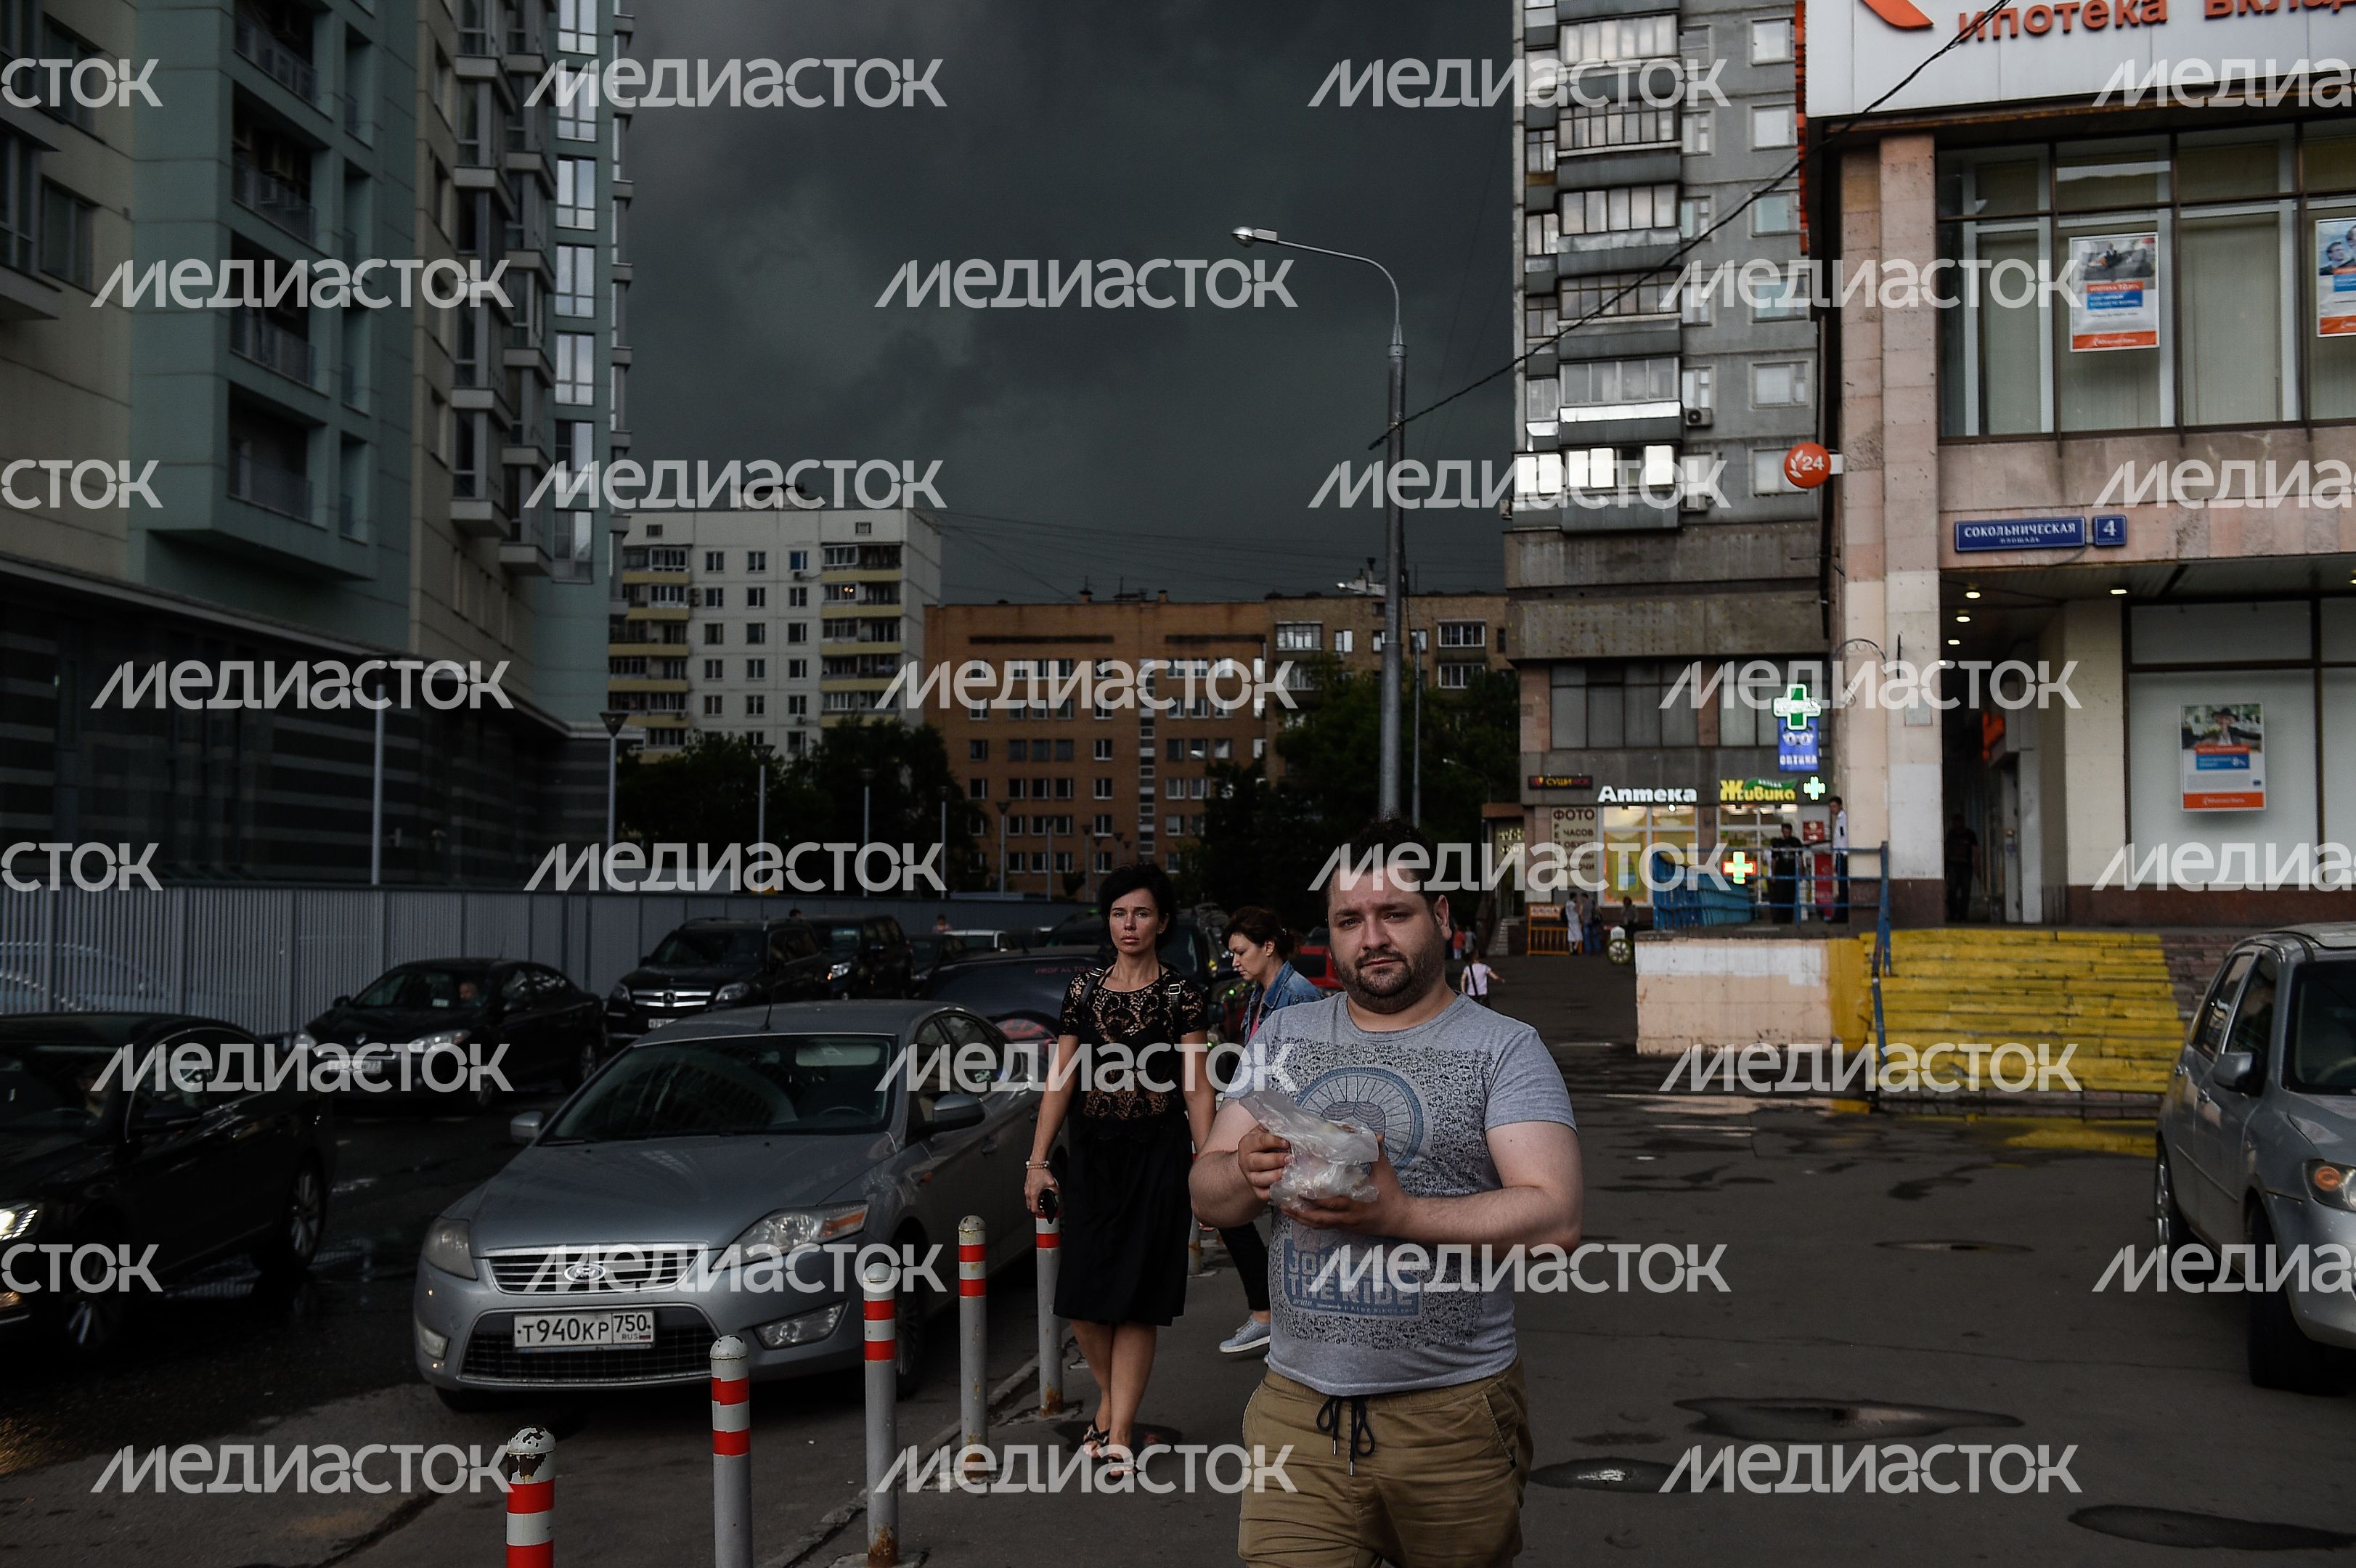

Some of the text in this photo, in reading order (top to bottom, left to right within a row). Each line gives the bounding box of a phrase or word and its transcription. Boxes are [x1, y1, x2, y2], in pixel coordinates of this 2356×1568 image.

[1959, 0, 2168, 42] ипотека
[1801, 454, 1825, 470] 24
[1965, 520, 2117, 538] СОКОЛЬНИЧЕСКАЯ 4
[1597, 785, 1697, 803] Аптека
[1720, 779, 1796, 801] Живика
[1553, 809, 1595, 821] ФОТО
[1288, 1273, 1413, 1305] THE RIDE
[522, 1314, 648, 1343] Т940КР 750
